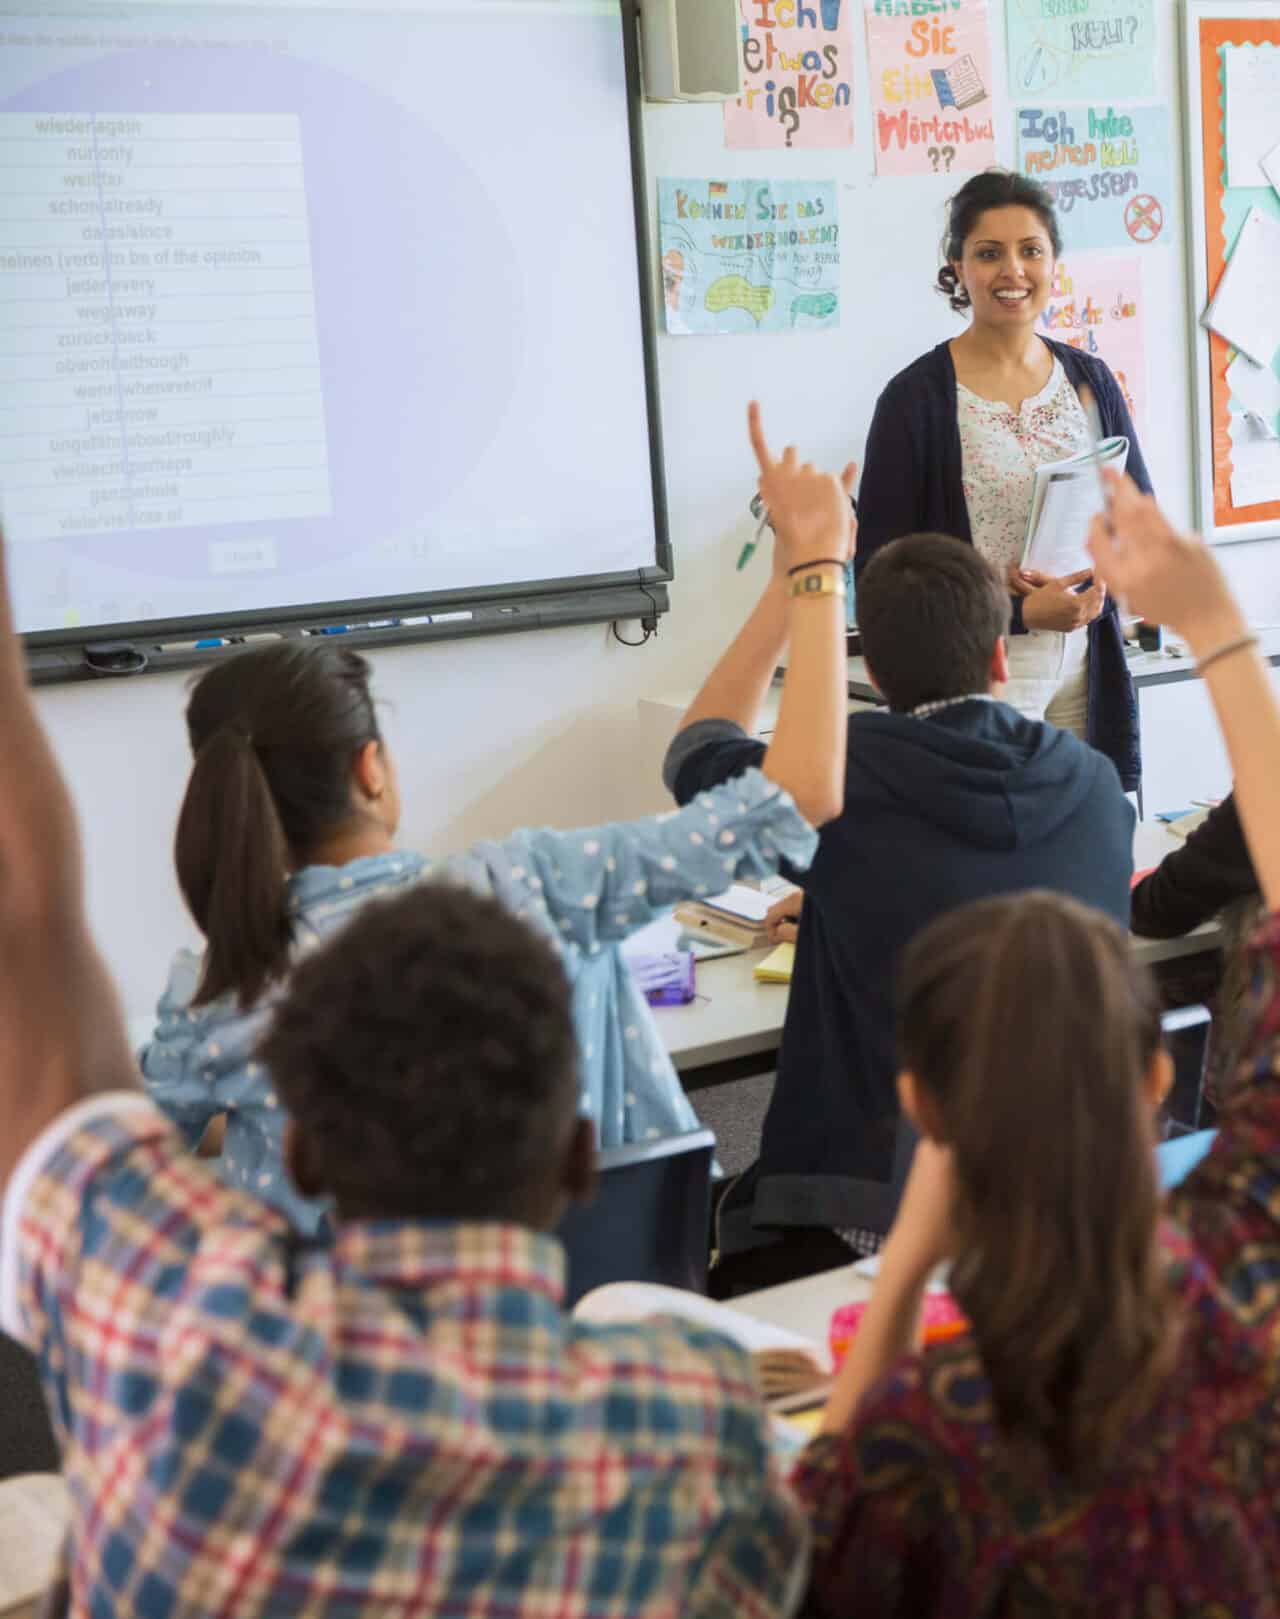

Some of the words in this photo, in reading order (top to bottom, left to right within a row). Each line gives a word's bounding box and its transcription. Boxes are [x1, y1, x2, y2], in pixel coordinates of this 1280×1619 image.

[752, 0, 817, 28] Ich
[743, 31, 838, 79] etwas
[1019, 110, 1074, 144] Ich
[104, 198, 163, 216] already
[154, 249, 169, 265] of
[173, 248, 197, 264] the
[202, 248, 261, 270] opinion
